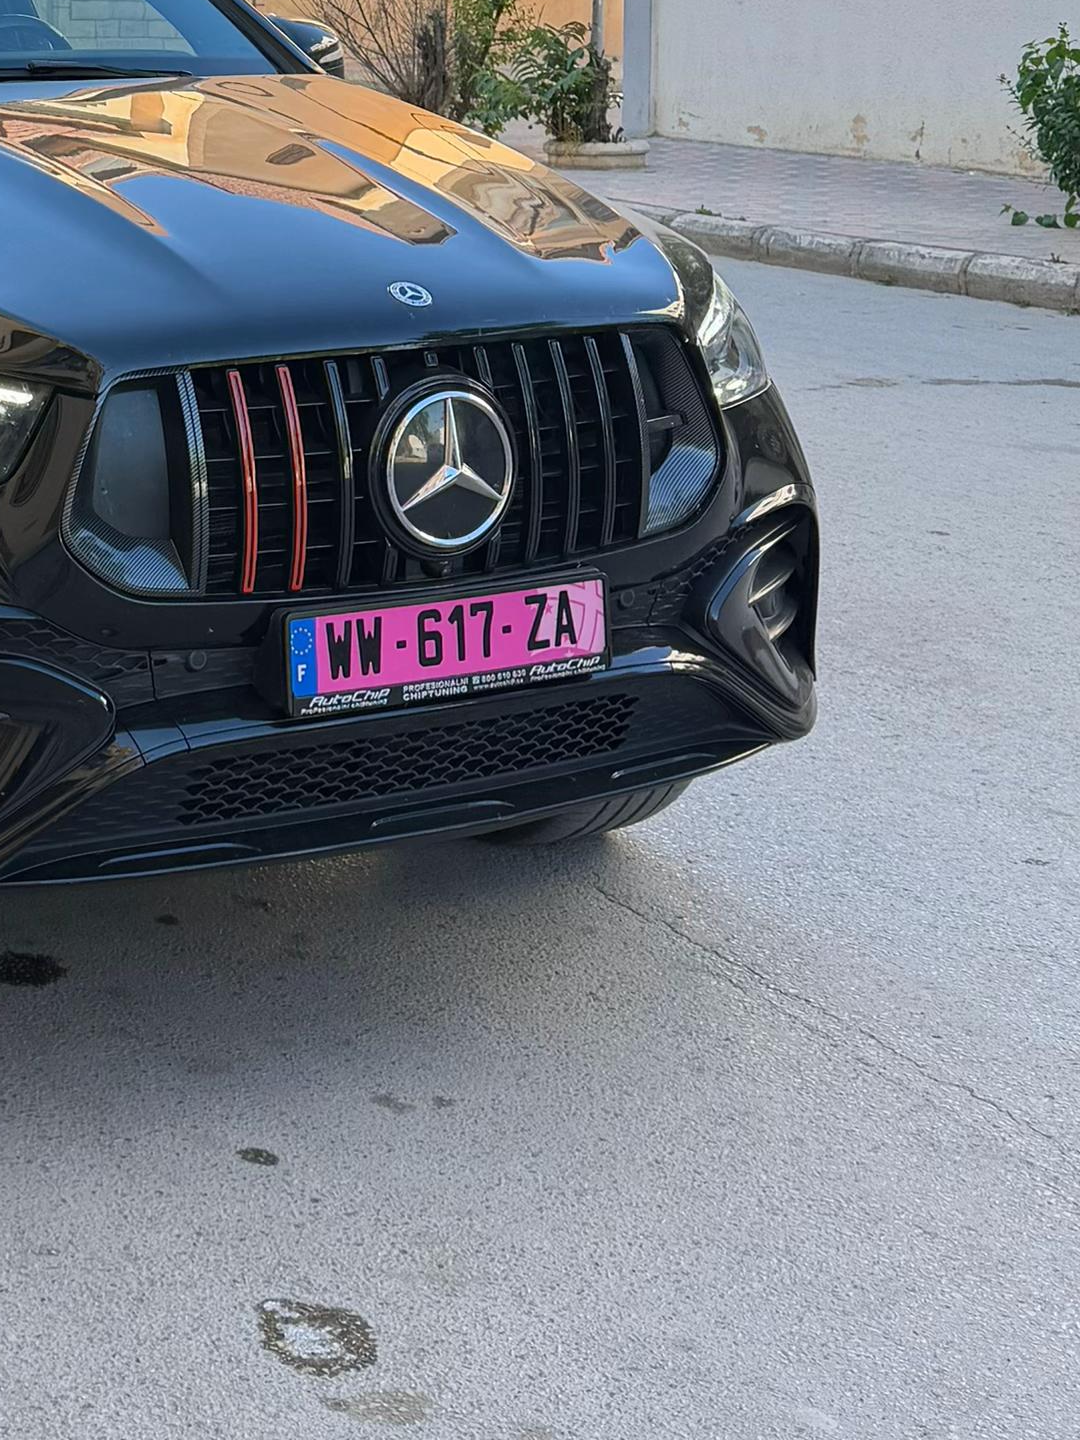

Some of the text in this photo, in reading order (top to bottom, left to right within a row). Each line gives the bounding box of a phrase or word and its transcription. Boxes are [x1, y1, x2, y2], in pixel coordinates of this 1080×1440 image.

[297, 664, 307, 682] F
[529, 655, 601, 676] AutoChip
[309, 688, 390, 707] AutoChip
[402, 685, 468, 701] CHIPTUNING
